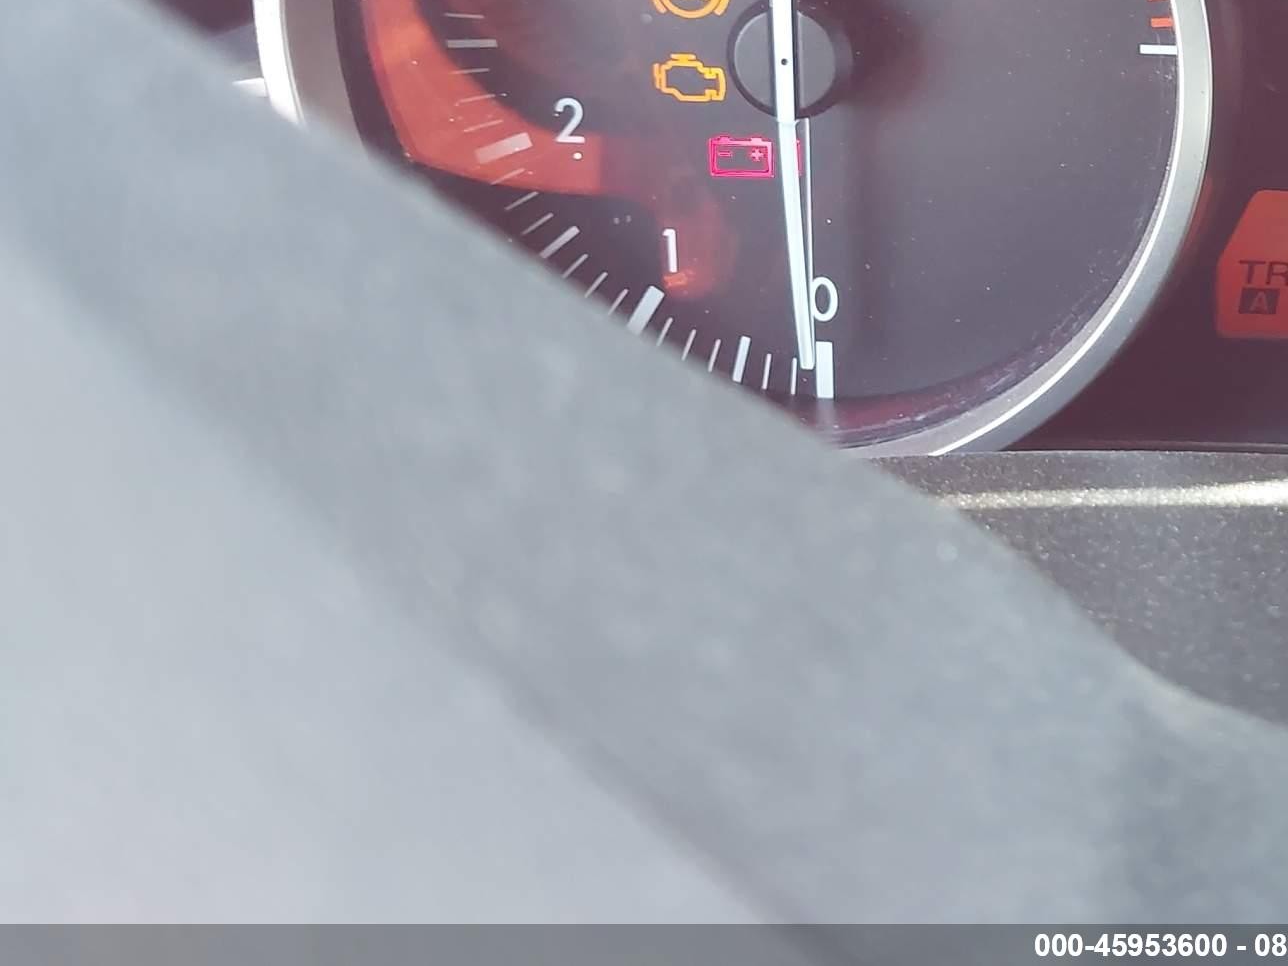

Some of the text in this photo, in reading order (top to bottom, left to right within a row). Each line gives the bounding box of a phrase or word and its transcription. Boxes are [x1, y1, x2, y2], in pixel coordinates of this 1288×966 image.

[555, 97, 586, 144] 2
[662, 228, 679, 273] 1
[811, 276, 841, 323] 0
